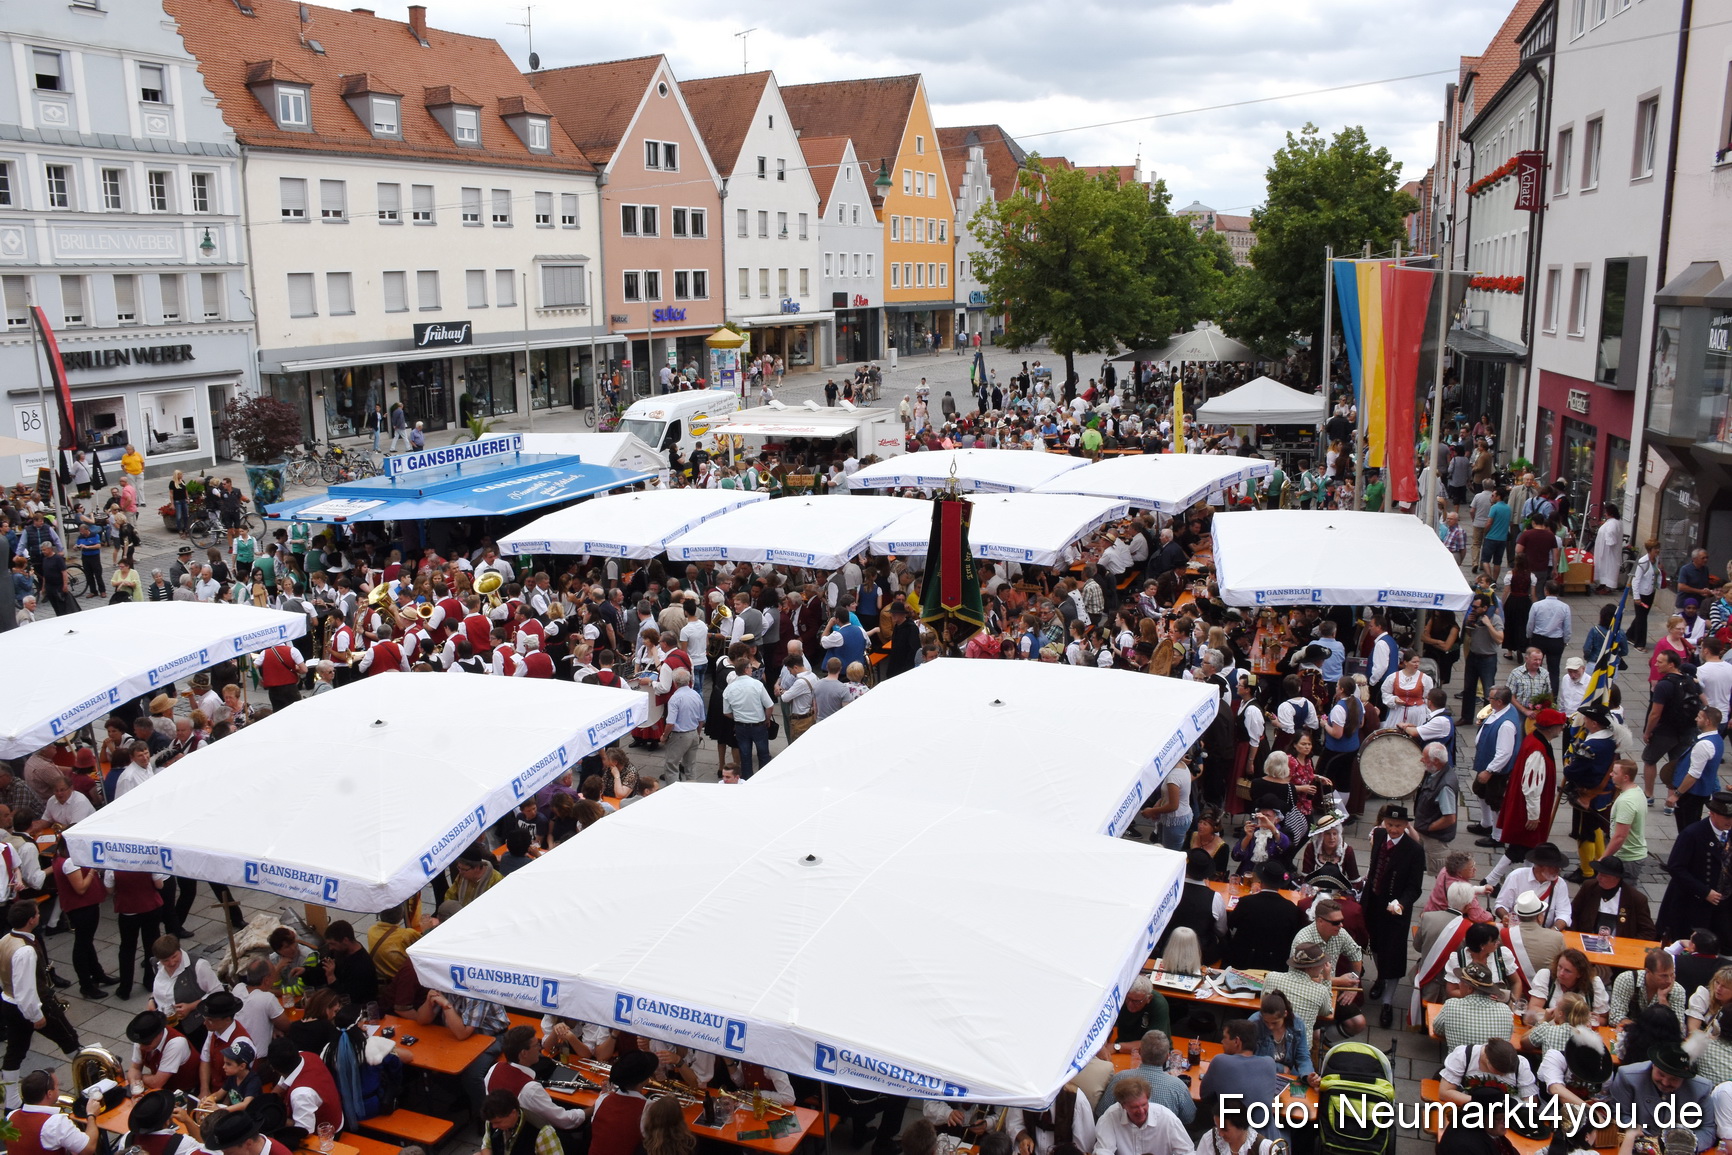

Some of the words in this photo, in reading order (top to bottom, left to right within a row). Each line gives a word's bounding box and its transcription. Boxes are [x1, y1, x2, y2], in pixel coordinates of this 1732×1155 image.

[1521, 163, 1536, 206] Achatz
[59, 233, 120, 250] BRILLEN
[121, 234, 175, 250] WEBER
[418, 323, 471, 346] frühauf
[61, 350, 131, 371] BRILLEN
[131, 344, 196, 364] WEBER
[1566, 389, 1587, 411] Achatz
[407, 438, 511, 471] GANSBRAUEREI
[260, 862, 324, 885] GANSBRÄU
[467, 966, 540, 989] GANSBRÄU
[636, 997, 725, 1029] GANSBRÄU
[633, 1016, 673, 1032] Neumarkt's
[674, 1026, 692, 1036] guter
[691, 1030, 722, 1045] Schluck
[1076, 994, 1114, 1060] GANSBRÄU
[838, 1066, 885, 1084] Neumarkt's
[886, 1080, 907, 1088] guter
[839, 1049, 942, 1089] GANSBRÄU
